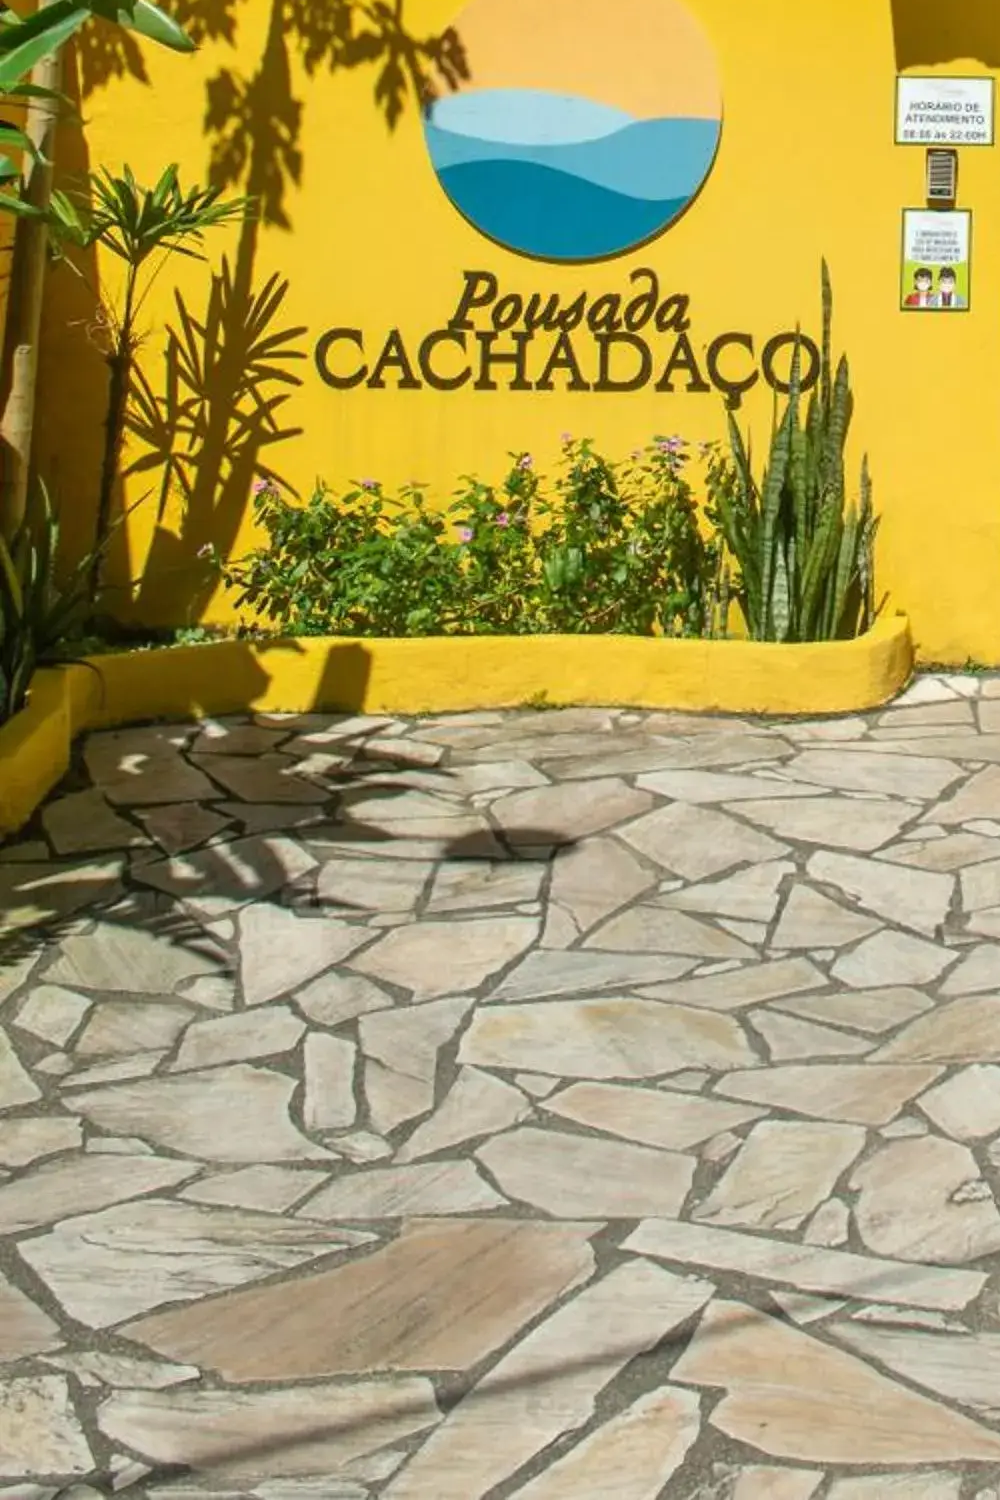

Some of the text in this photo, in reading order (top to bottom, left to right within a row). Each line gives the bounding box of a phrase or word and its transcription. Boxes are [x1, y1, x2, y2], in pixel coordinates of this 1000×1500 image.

[905, 113, 985, 125] ATENDIMENTO
[965, 102, 980, 113] DE
[448, 267, 692, 333] Pousada
[314, 327, 822, 411] CACHADAÇO
